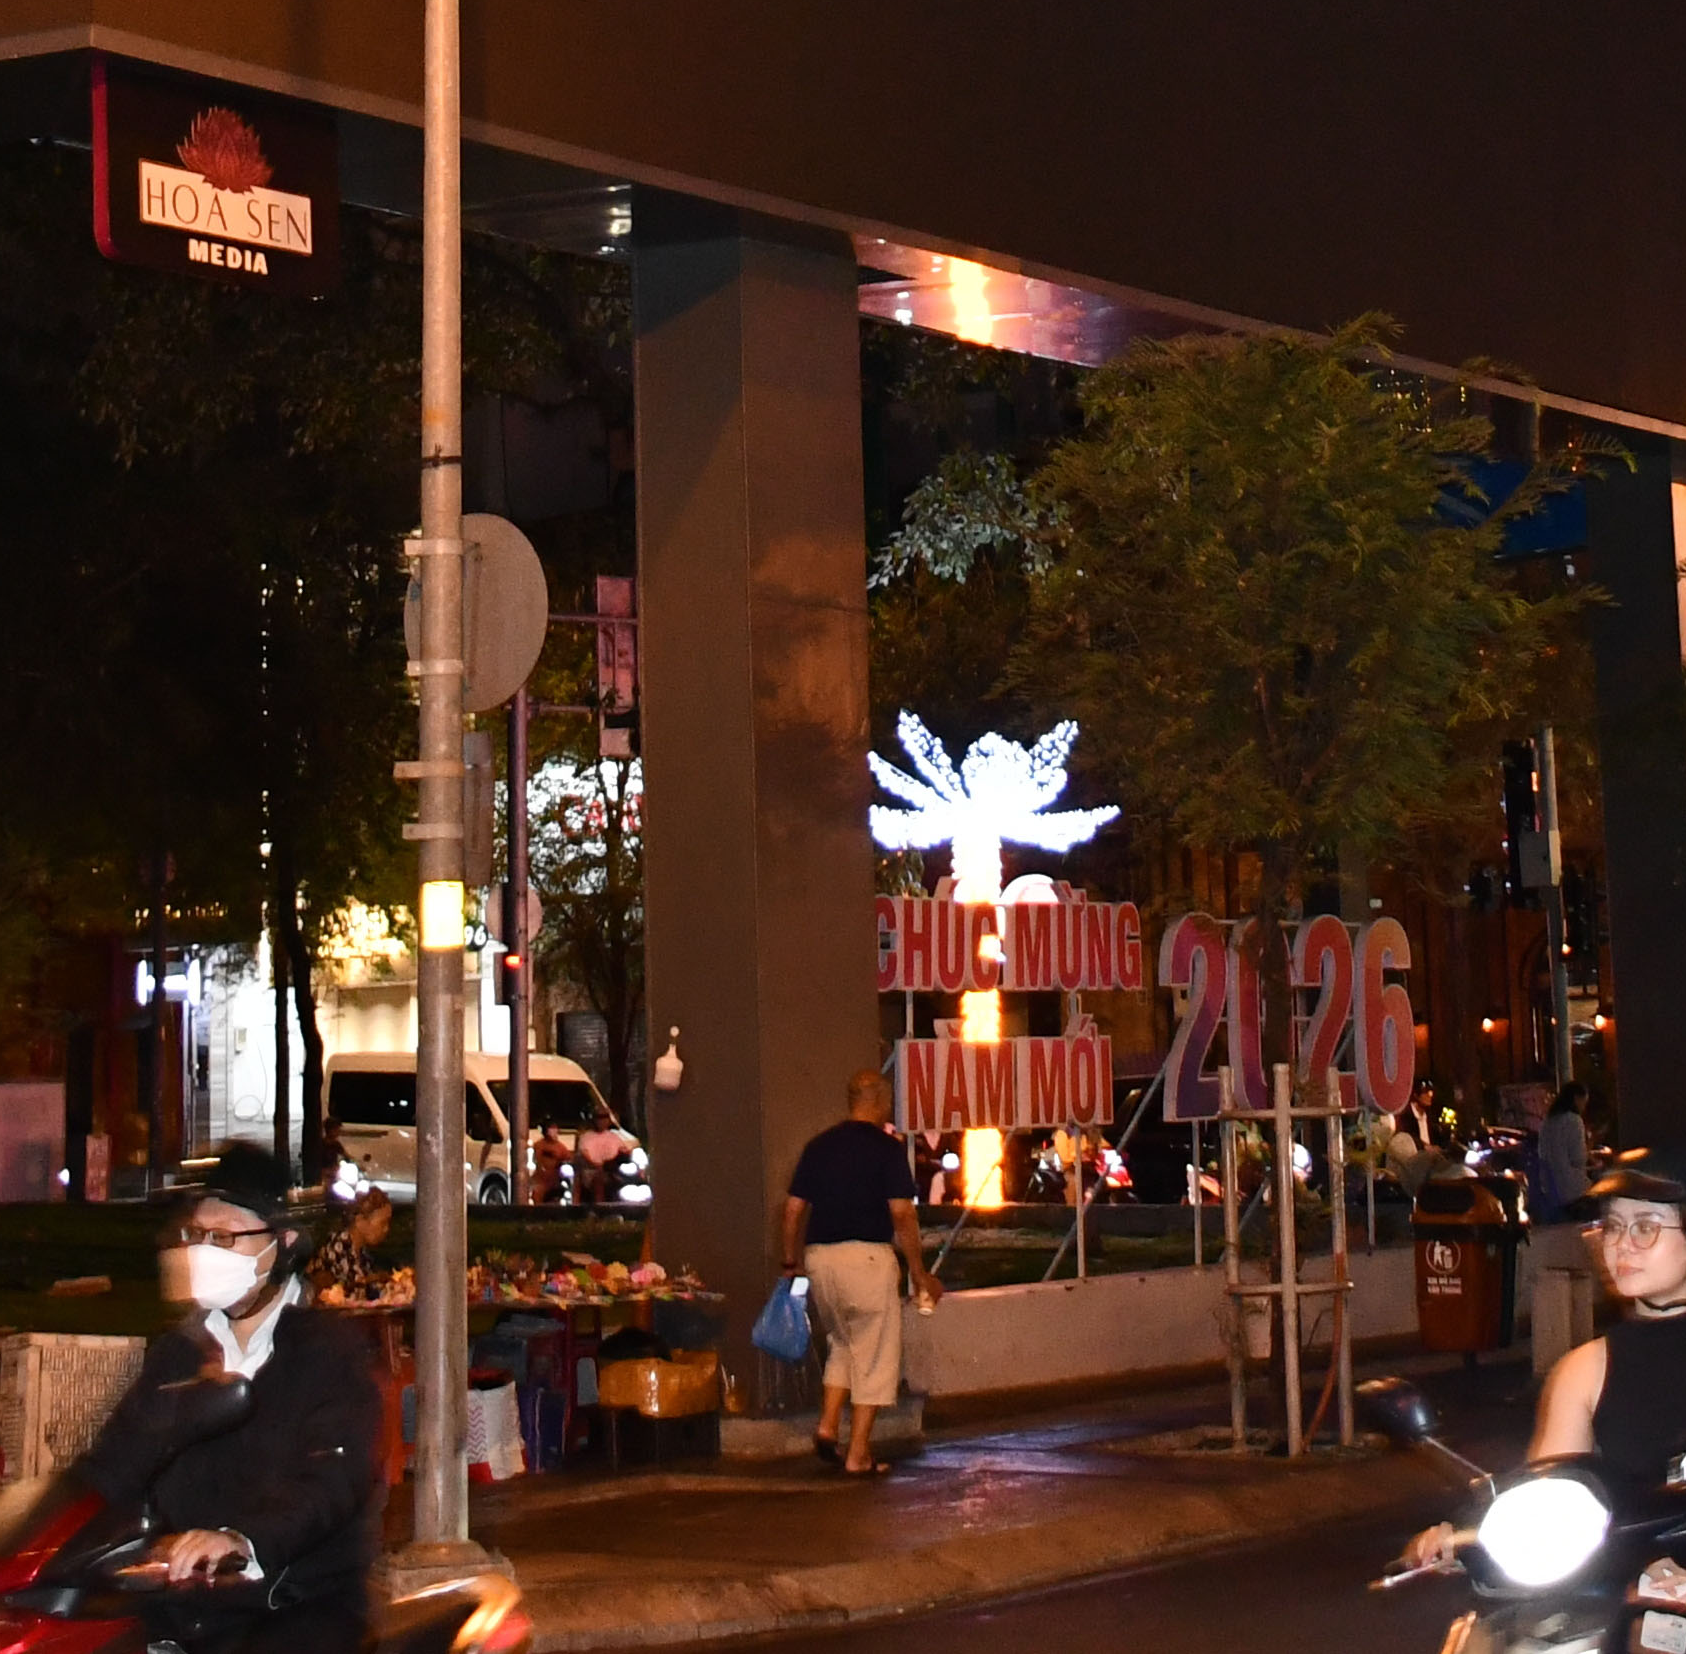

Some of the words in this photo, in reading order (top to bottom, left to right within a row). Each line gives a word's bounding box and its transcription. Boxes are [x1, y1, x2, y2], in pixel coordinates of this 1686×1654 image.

[146, 176, 228, 232] HOA
[247, 198, 309, 249] SEN
[188, 238, 269, 275] MEDIA
[1014, 881, 1142, 990] MỪNG
[1029, 1015, 1113, 1125] MỚI
